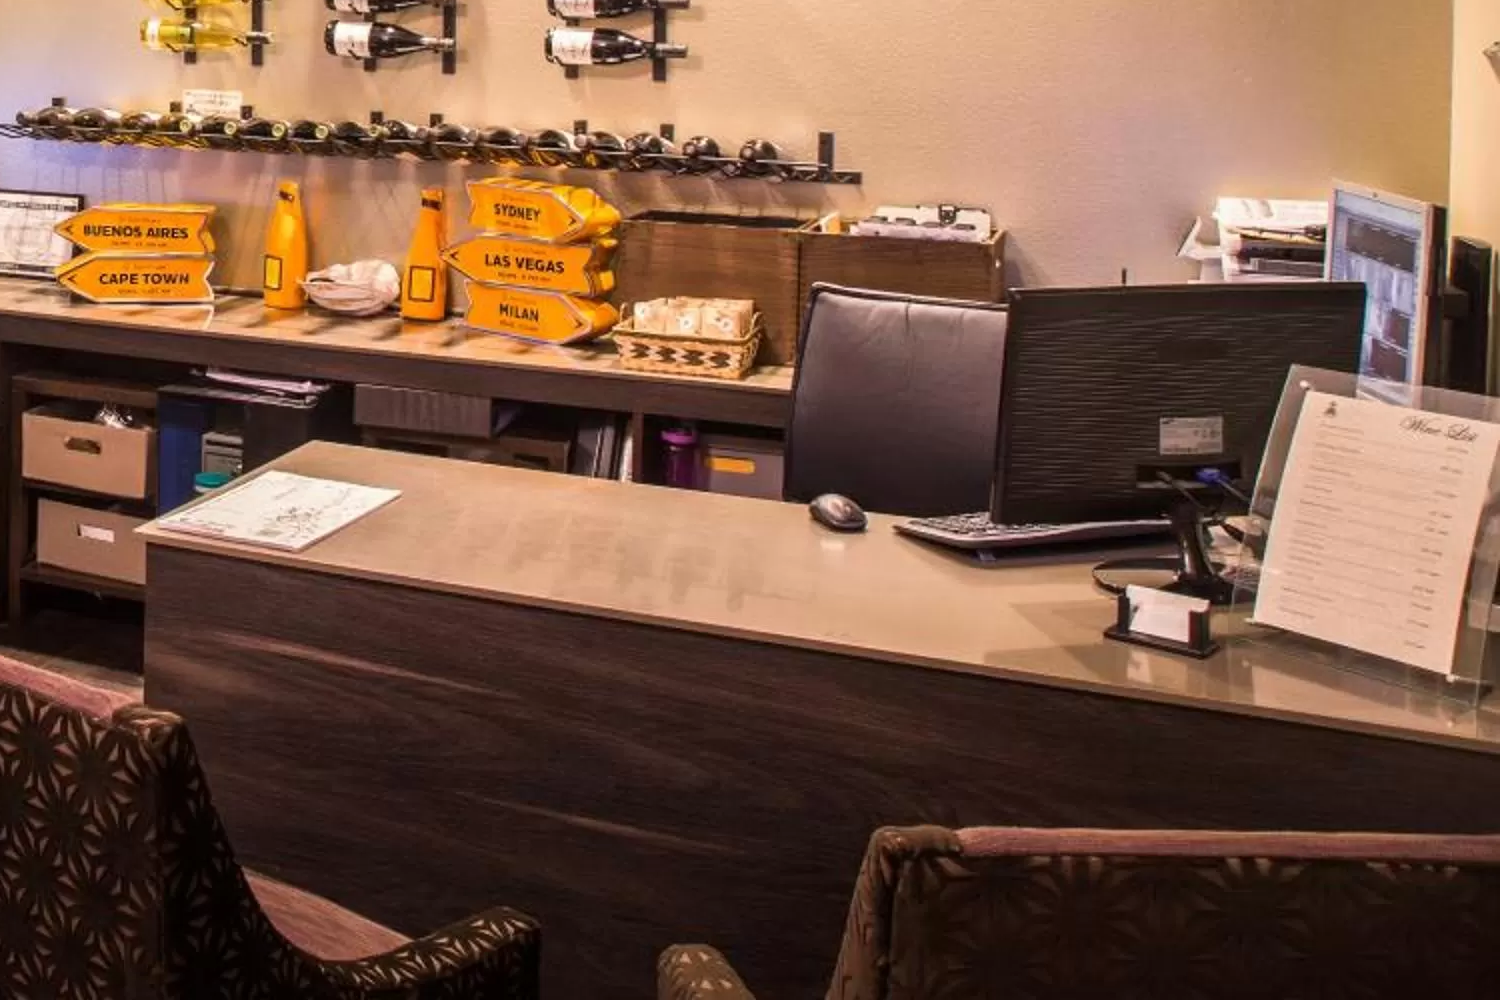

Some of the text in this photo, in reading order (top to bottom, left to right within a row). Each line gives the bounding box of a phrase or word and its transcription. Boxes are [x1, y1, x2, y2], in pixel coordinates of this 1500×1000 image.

[493, 203, 541, 221] SYDNEY
[83, 225, 189, 239] BUENOS AIRES
[485, 254, 565, 274] LAS VEGAS
[99, 273, 189, 285] CAPE TOWN
[499, 303, 539, 322] MILAN
[1399, 415, 1479, 441] Wine List
